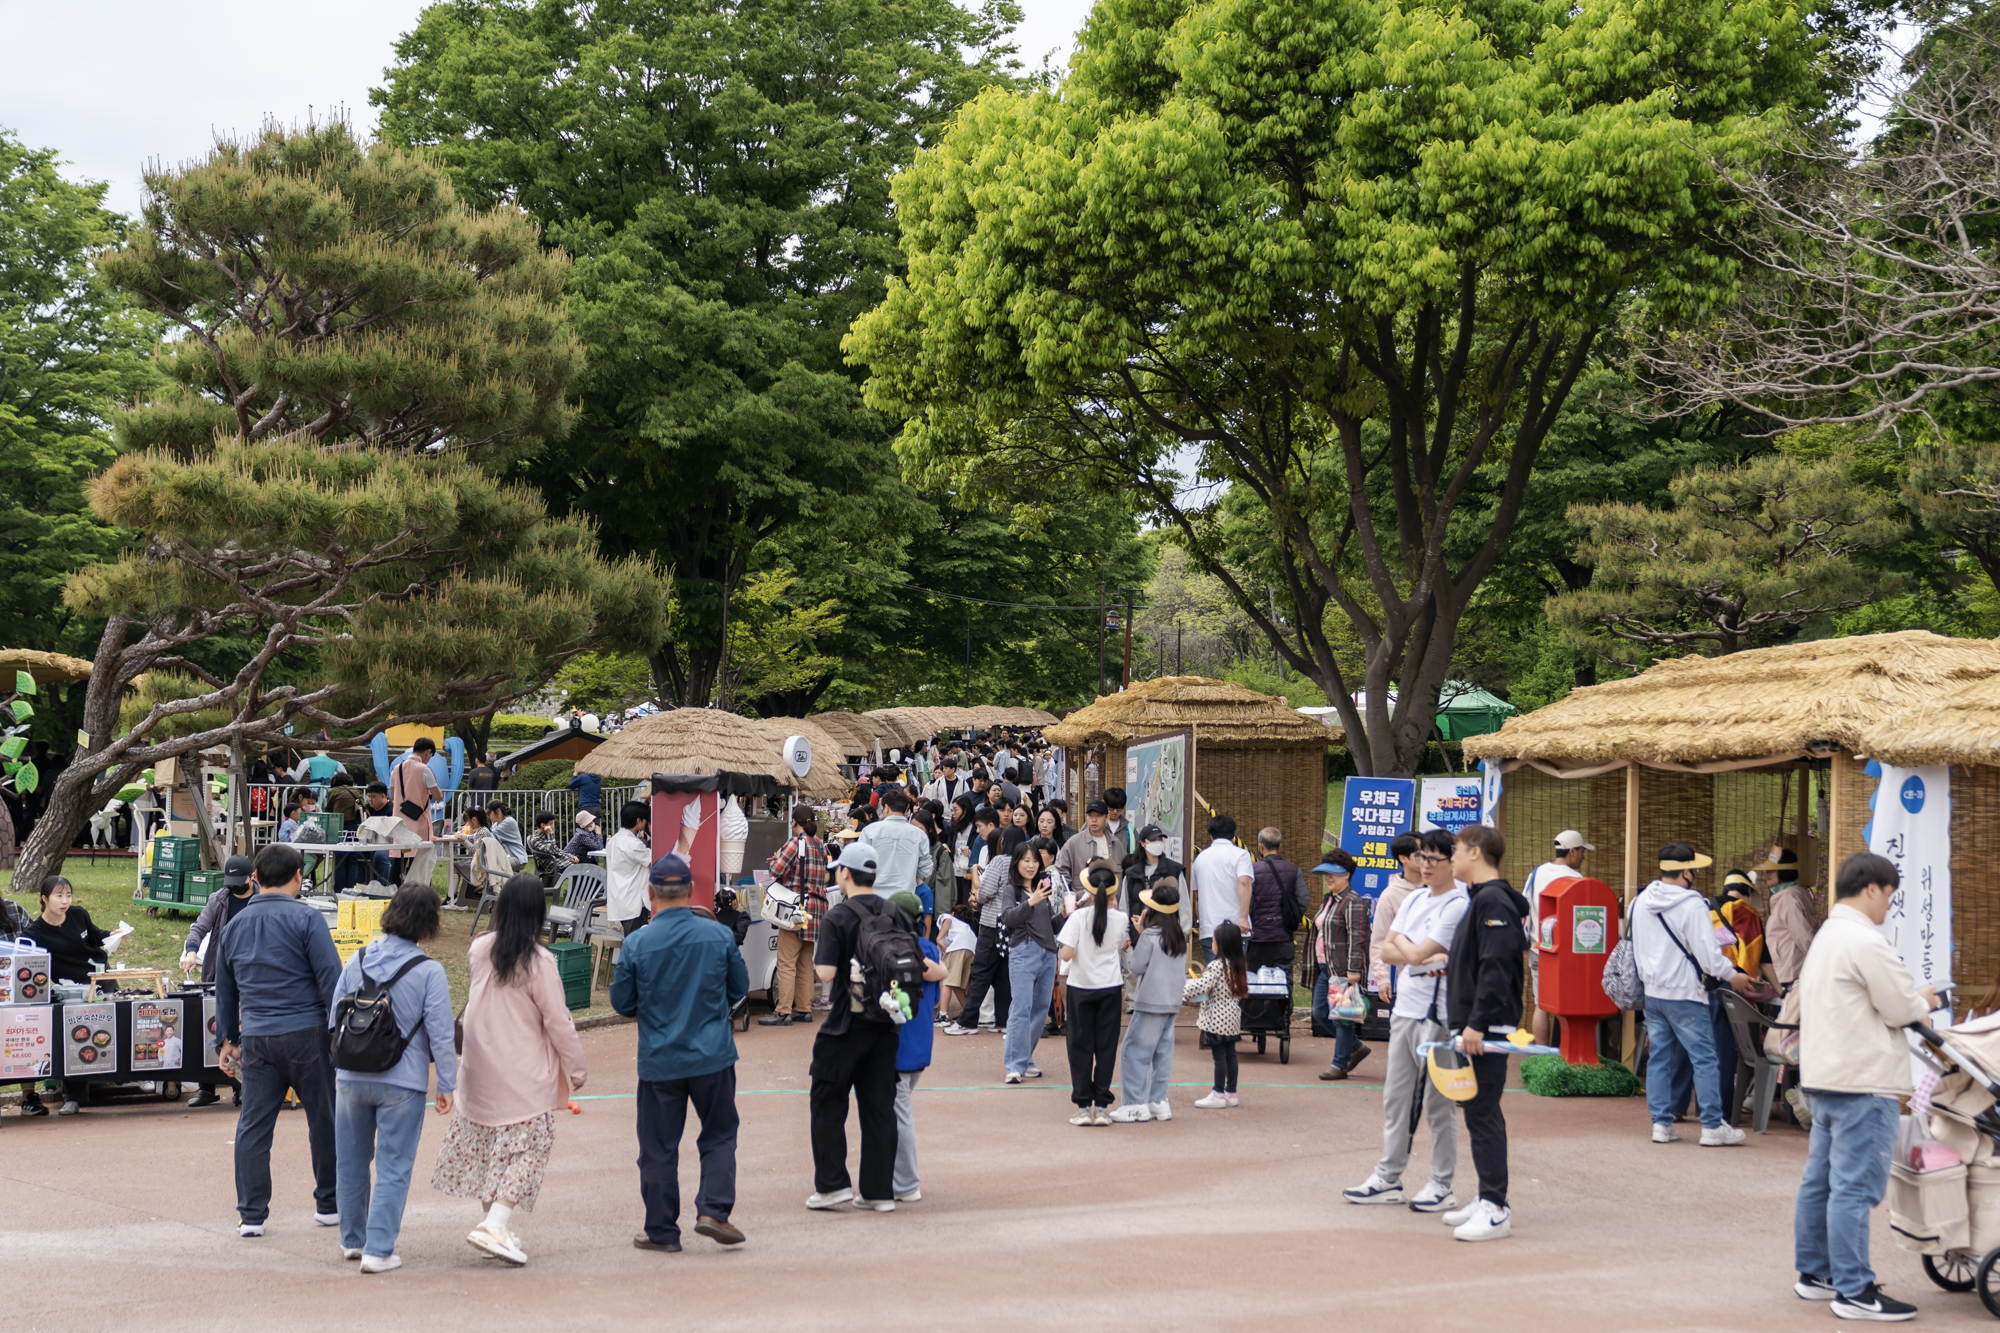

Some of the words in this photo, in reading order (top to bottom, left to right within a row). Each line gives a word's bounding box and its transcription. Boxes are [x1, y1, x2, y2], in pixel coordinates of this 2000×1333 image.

[1455, 785, 1478, 795] 당신을
[1359, 790, 1400, 806] 우체국
[1436, 797, 1478, 809] 우체국FC
[1351, 807, 1405, 824] 잇다뱅킹
[1426, 811, 1477, 821] (보험설계사)로
[1358, 824, 1396, 837] 가입하고
[1362, 841, 1388, 856] 선물
[1352, 856, 1398, 869] 아가세요!
[25, 1027, 38, 1035] 도전
